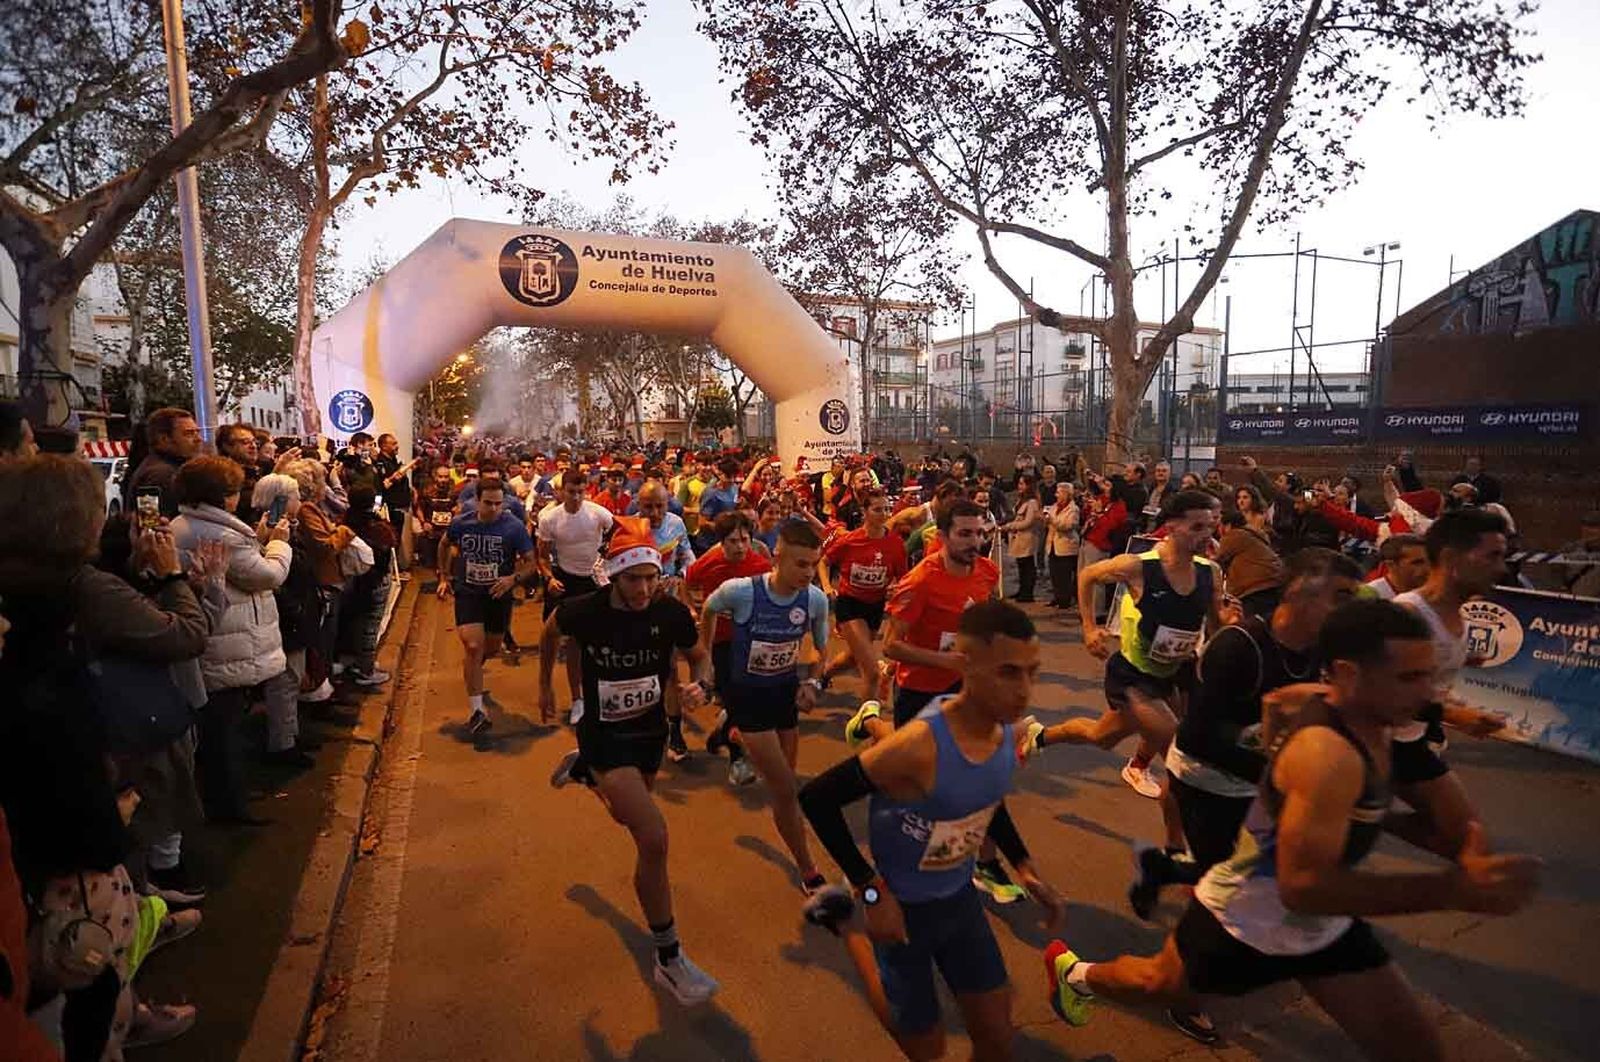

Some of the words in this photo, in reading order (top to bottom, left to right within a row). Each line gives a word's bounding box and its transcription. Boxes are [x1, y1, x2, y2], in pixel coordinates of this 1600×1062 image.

[582, 245, 714, 267] Ayuntamiento
[622, 264, 645, 279] de
[651, 265, 716, 283] Huelva
[652, 285, 666, 294] de
[669, 285, 718, 297] Deportes
[1313, 418, 1359, 427] HYUNDAI
[1407, 415, 1464, 425] HYUNDAI
[1508, 412, 1580, 424] HYUNDAI
[1245, 420, 1285, 429] HYUNDAI
[770, 652, 794, 666] 567
[624, 690, 654, 707] 610
